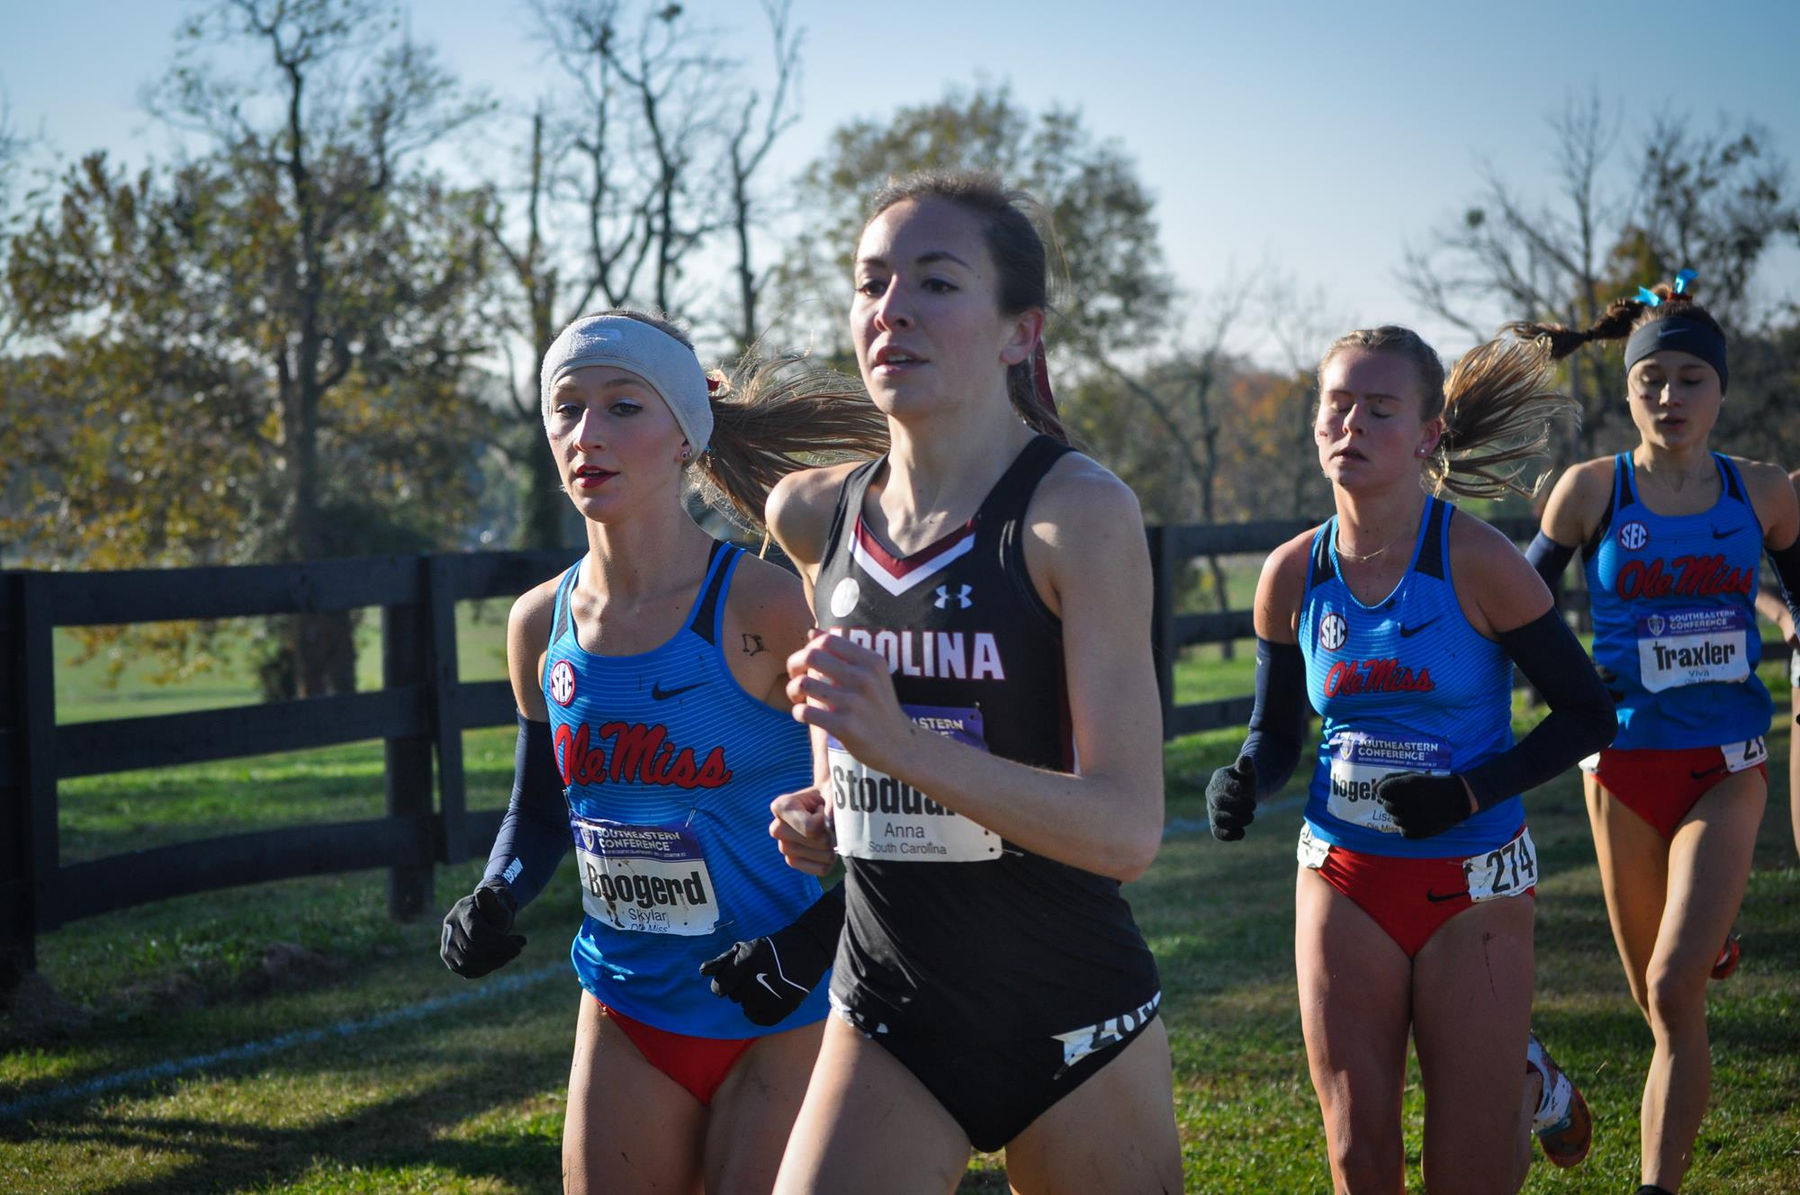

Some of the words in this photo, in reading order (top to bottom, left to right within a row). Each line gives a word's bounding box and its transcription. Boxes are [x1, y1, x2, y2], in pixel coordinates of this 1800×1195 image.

[1620, 523, 1648, 550] SEC
[1616, 558, 1674, 600] Ole
[1671, 554, 1754, 597] Miss
[1669, 611, 1736, 622] SOUTHEASTERN
[1669, 618, 1727, 630] CONFERENCE
[1321, 614, 1346, 650] SEC
[1652, 641, 1736, 671] Traxler
[552, 665, 573, 703] SEC
[1323, 660, 1363, 698] Ole
[1362, 658, 1435, 692] Miss
[554, 722, 606, 787] Ole
[599, 720, 733, 790] Miss
[1357, 739, 1439, 753] SOUTHEASTERN
[1357, 748, 1425, 761] CONFERENCE
[597, 828, 681, 840] SOUTHEASTERN
[884, 822, 925, 838] Anna
[598, 838, 671, 851] CONFERENCE
[869, 841, 897, 853] South
[900, 842, 947, 855] Carolina
[1486, 836, 1534, 894] 274
[586, 862, 707, 909] Boogerd
[628, 908, 667, 923] Skylar
